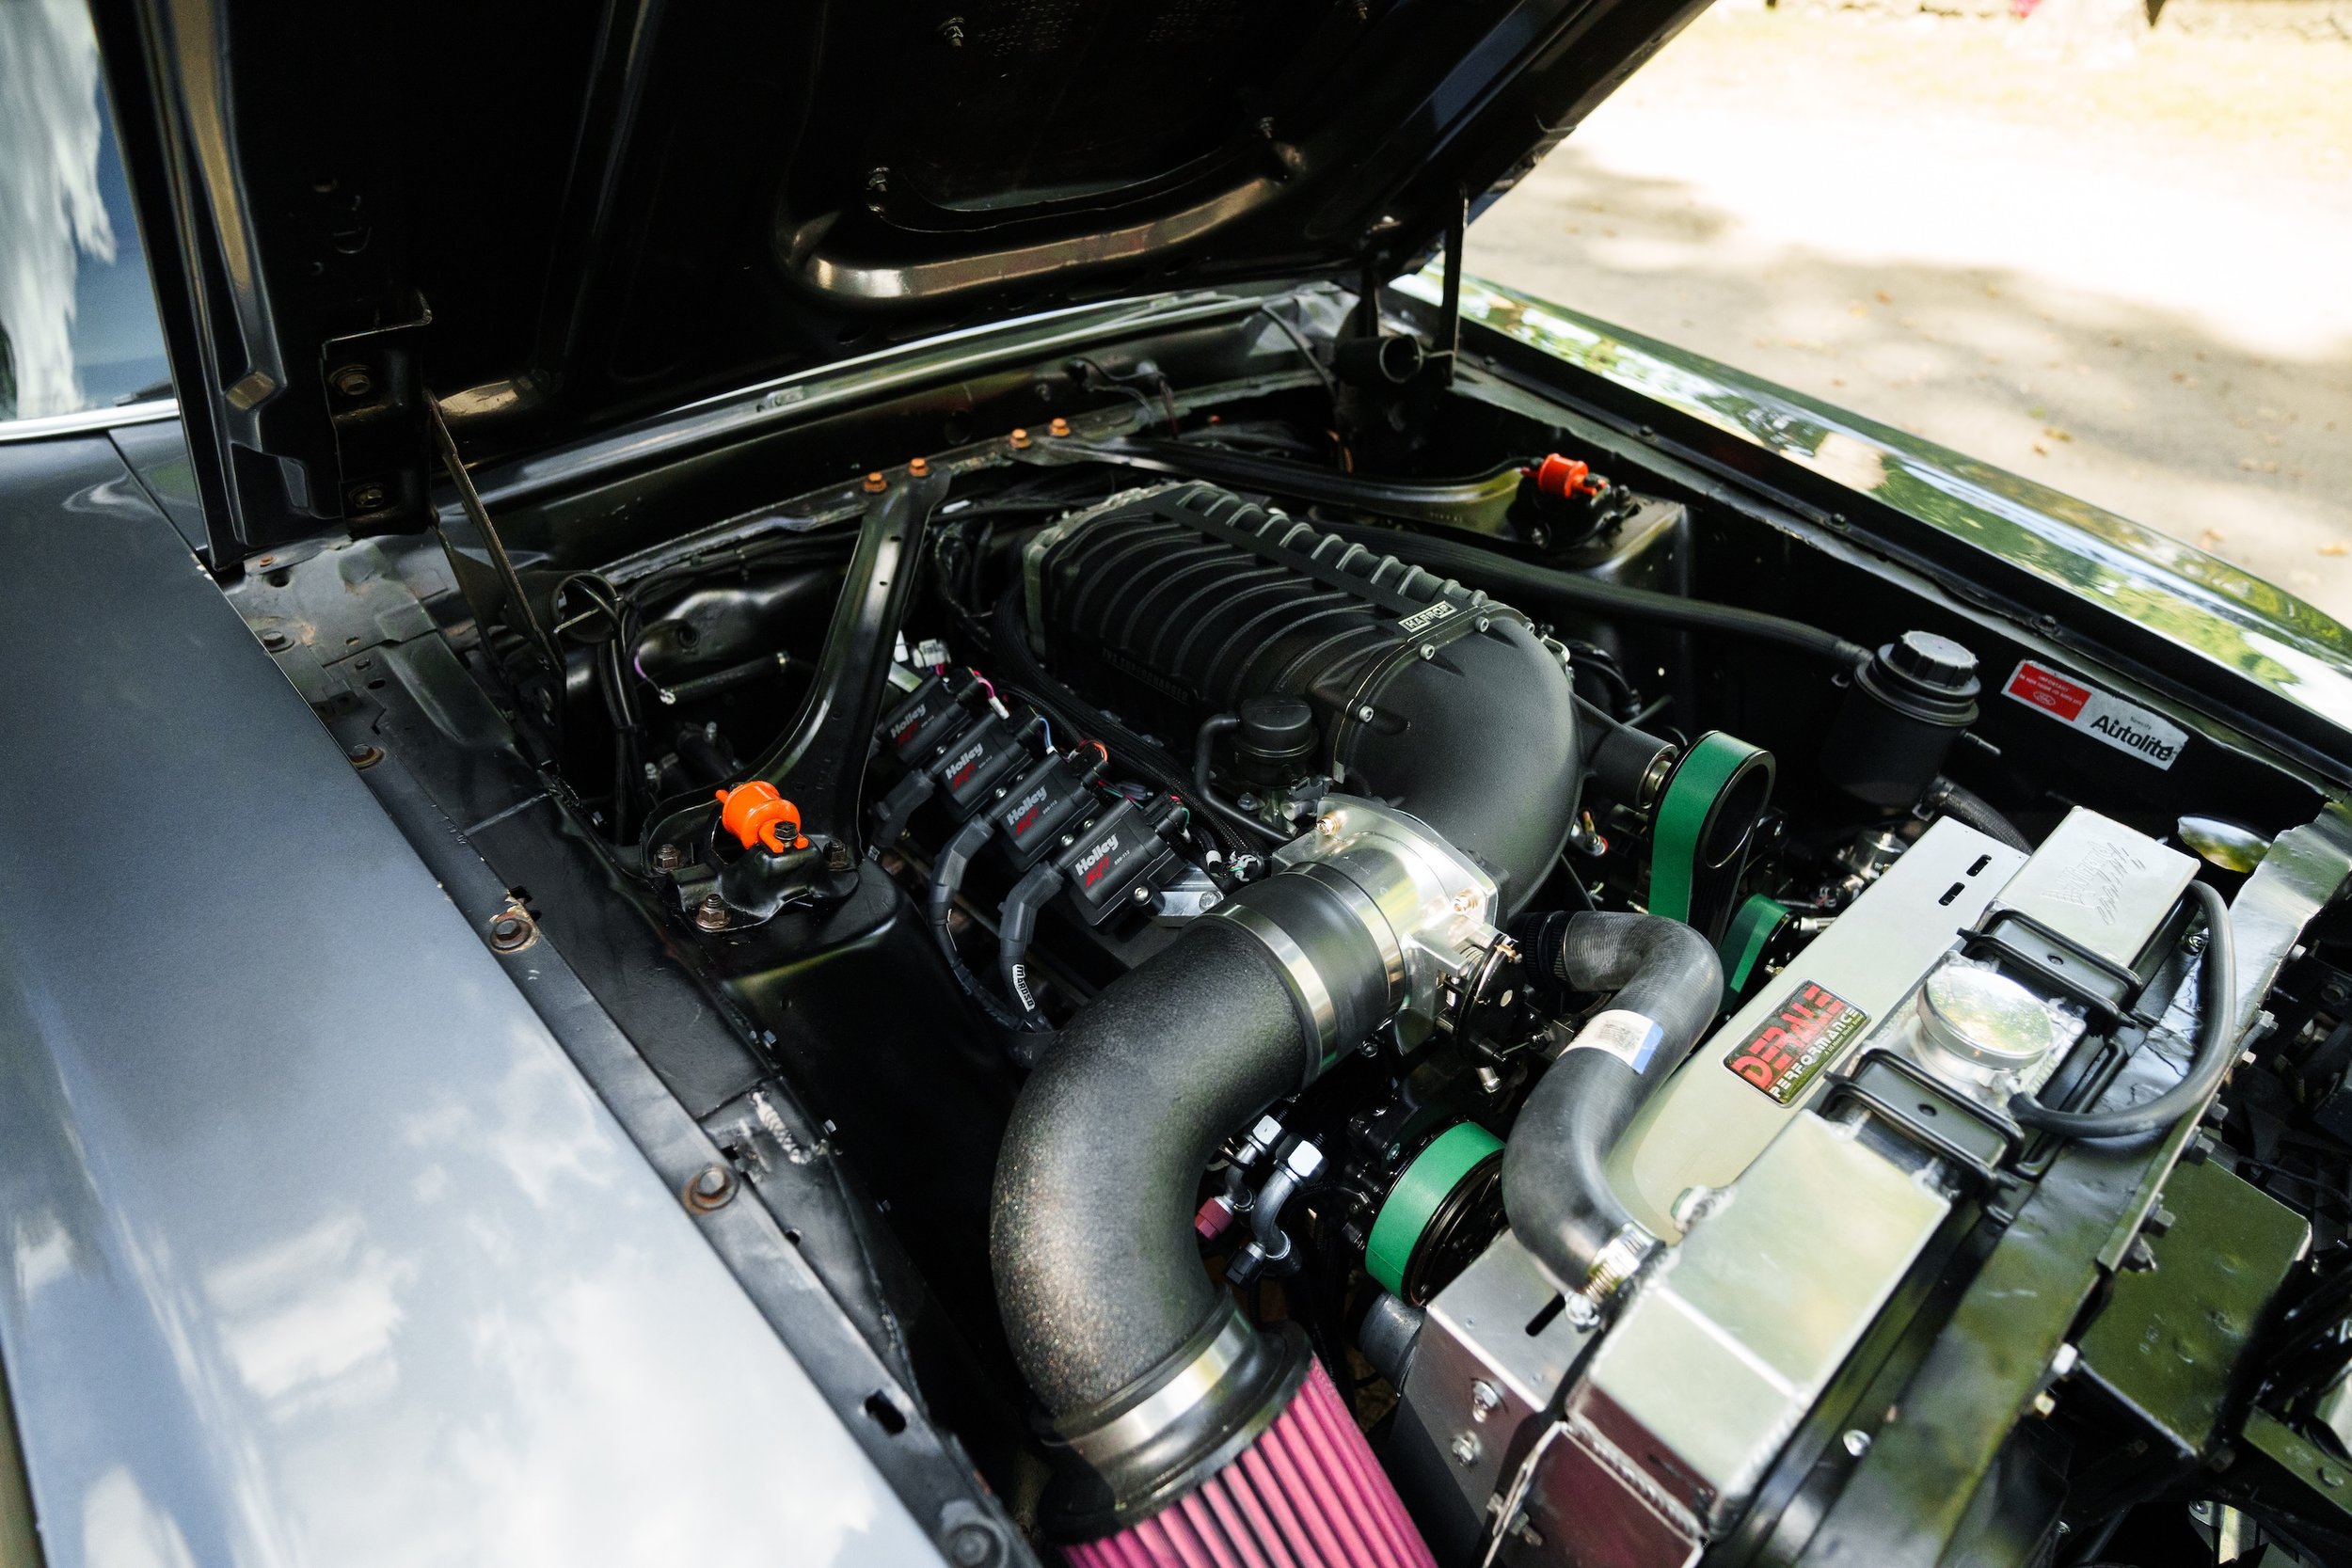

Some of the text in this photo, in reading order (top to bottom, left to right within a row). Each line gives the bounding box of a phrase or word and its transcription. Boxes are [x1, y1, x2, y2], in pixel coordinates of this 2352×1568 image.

[1402, 602, 1454, 630] HARROP
[890, 704, 927, 738] Holley
[2090, 715, 2174, 762] Autolite
[945, 742, 984, 780] Holley
[1007, 785, 1048, 826] Holley
[1074, 833, 1120, 876] Holley
[1730, 985, 1846, 1089] DERALE
[1769, 1007, 1860, 1099] PERFORMANCE
